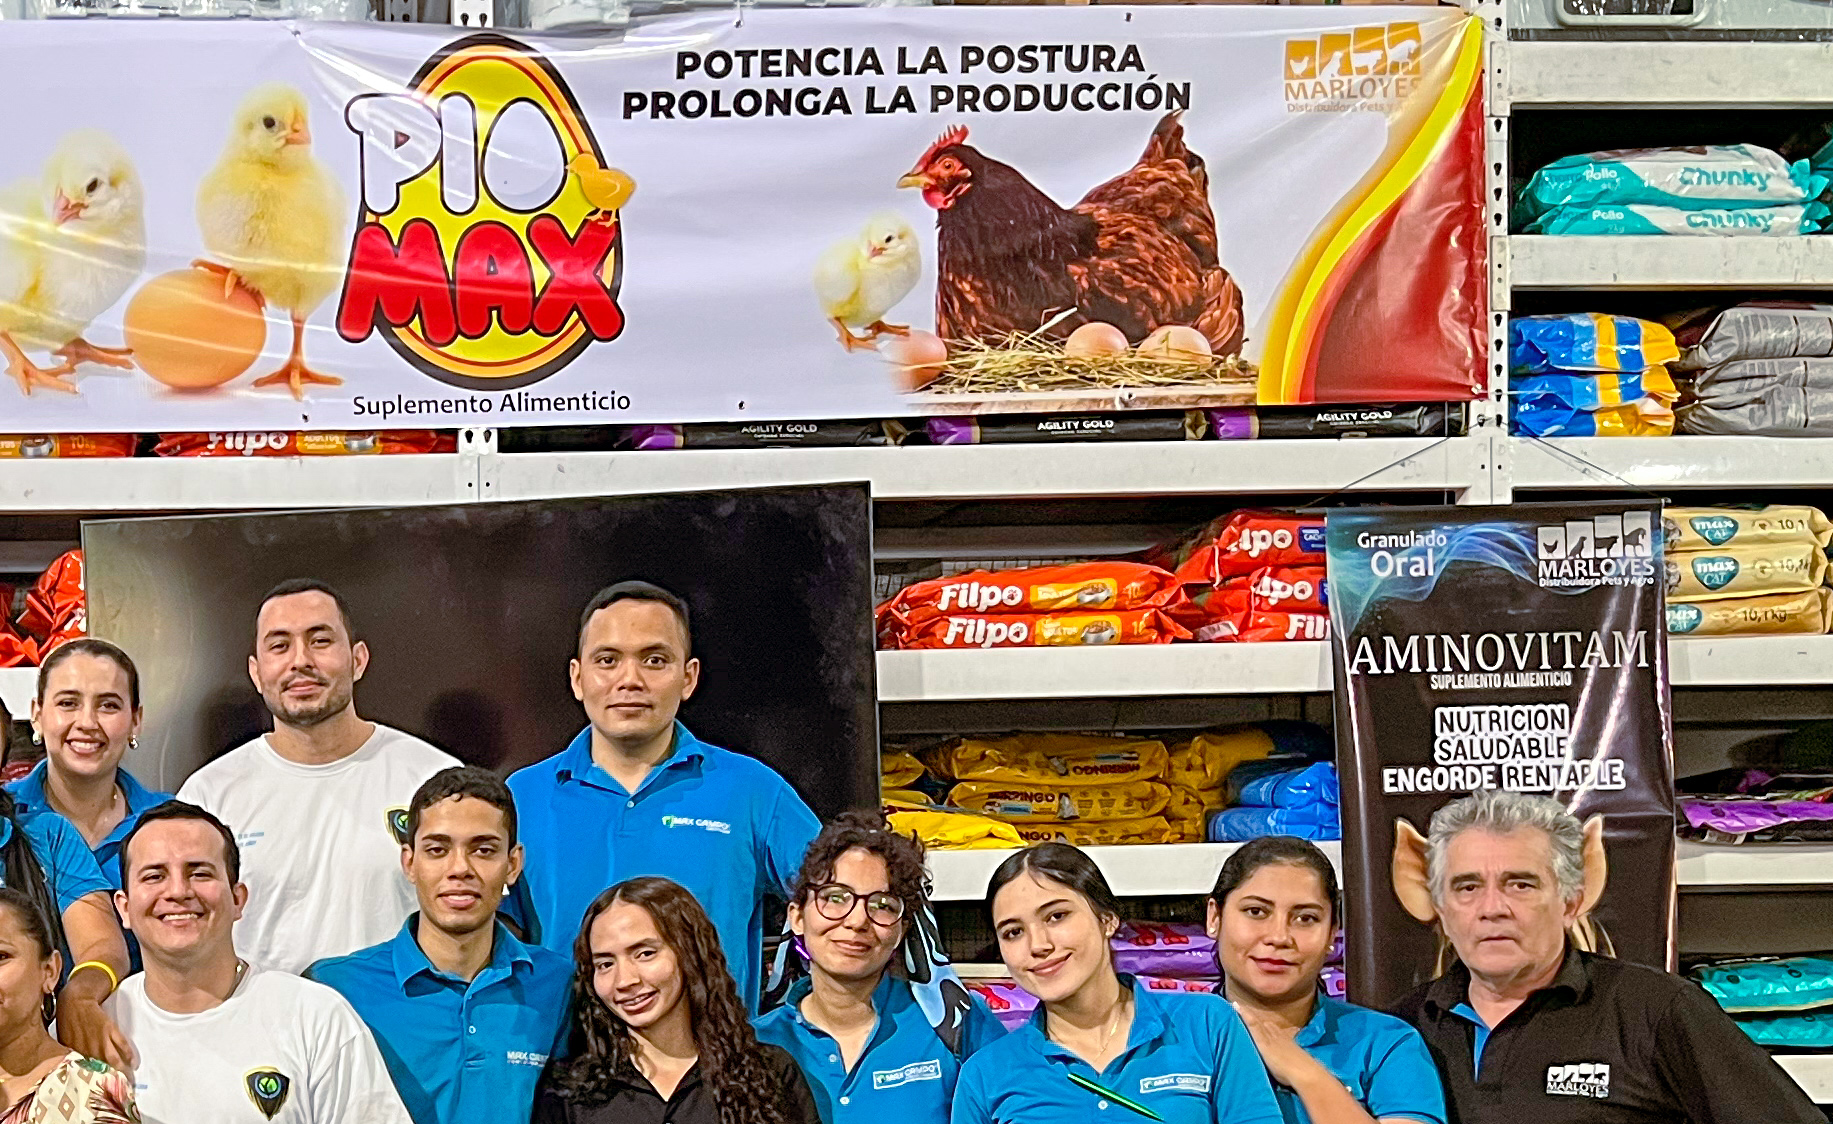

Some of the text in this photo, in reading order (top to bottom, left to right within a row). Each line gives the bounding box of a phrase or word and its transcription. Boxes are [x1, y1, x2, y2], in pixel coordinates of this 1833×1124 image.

[676, 44, 1146, 80] POTENCIA LA POSTURA
[623, 74, 1192, 120] PROLONGA LA PRODUCCIÓN
[1285, 77, 1419, 101] MARLOYES
[344, 92, 569, 215] PIO
[1679, 166, 1768, 192] Chunky
[1686, 211, 1775, 233] Chunky
[336, 213, 626, 347] MAX
[353, 391, 631, 419] Suplemento Alimenticio
[1315, 410, 1393, 422] AGILITY GOLD
[741, 423, 818, 434] AGILITY GOLD
[1037, 419, 1115, 431] AGILITY GOLD
[1695, 519, 1734, 530] max
[1357, 530, 1447, 549] Granulado
[1371, 551, 1435, 577] Oral
[1538, 558, 1655, 578] MARLOYES
[1697, 560, 1736, 573] max
[1539, 577, 1601, 588] Distribuidora
[1602, 576, 1623, 586] Pets
[1703, 574, 1726, 585] CAT
[937, 581, 1023, 613] Filpo
[943, 616, 1028, 648] Filpo
[1350, 631, 1650, 675] AMINOVITAM
[1430, 671, 1572, 690] SUPLEMENTO ALIMENTICIO
[1439, 708, 1566, 735] NUTRICION
[1438, 737, 1568, 761] SALUDABLE
[1383, 766, 1496, 793] ENGORDE
[1547, 1081, 1609, 1092] MARLOYES
